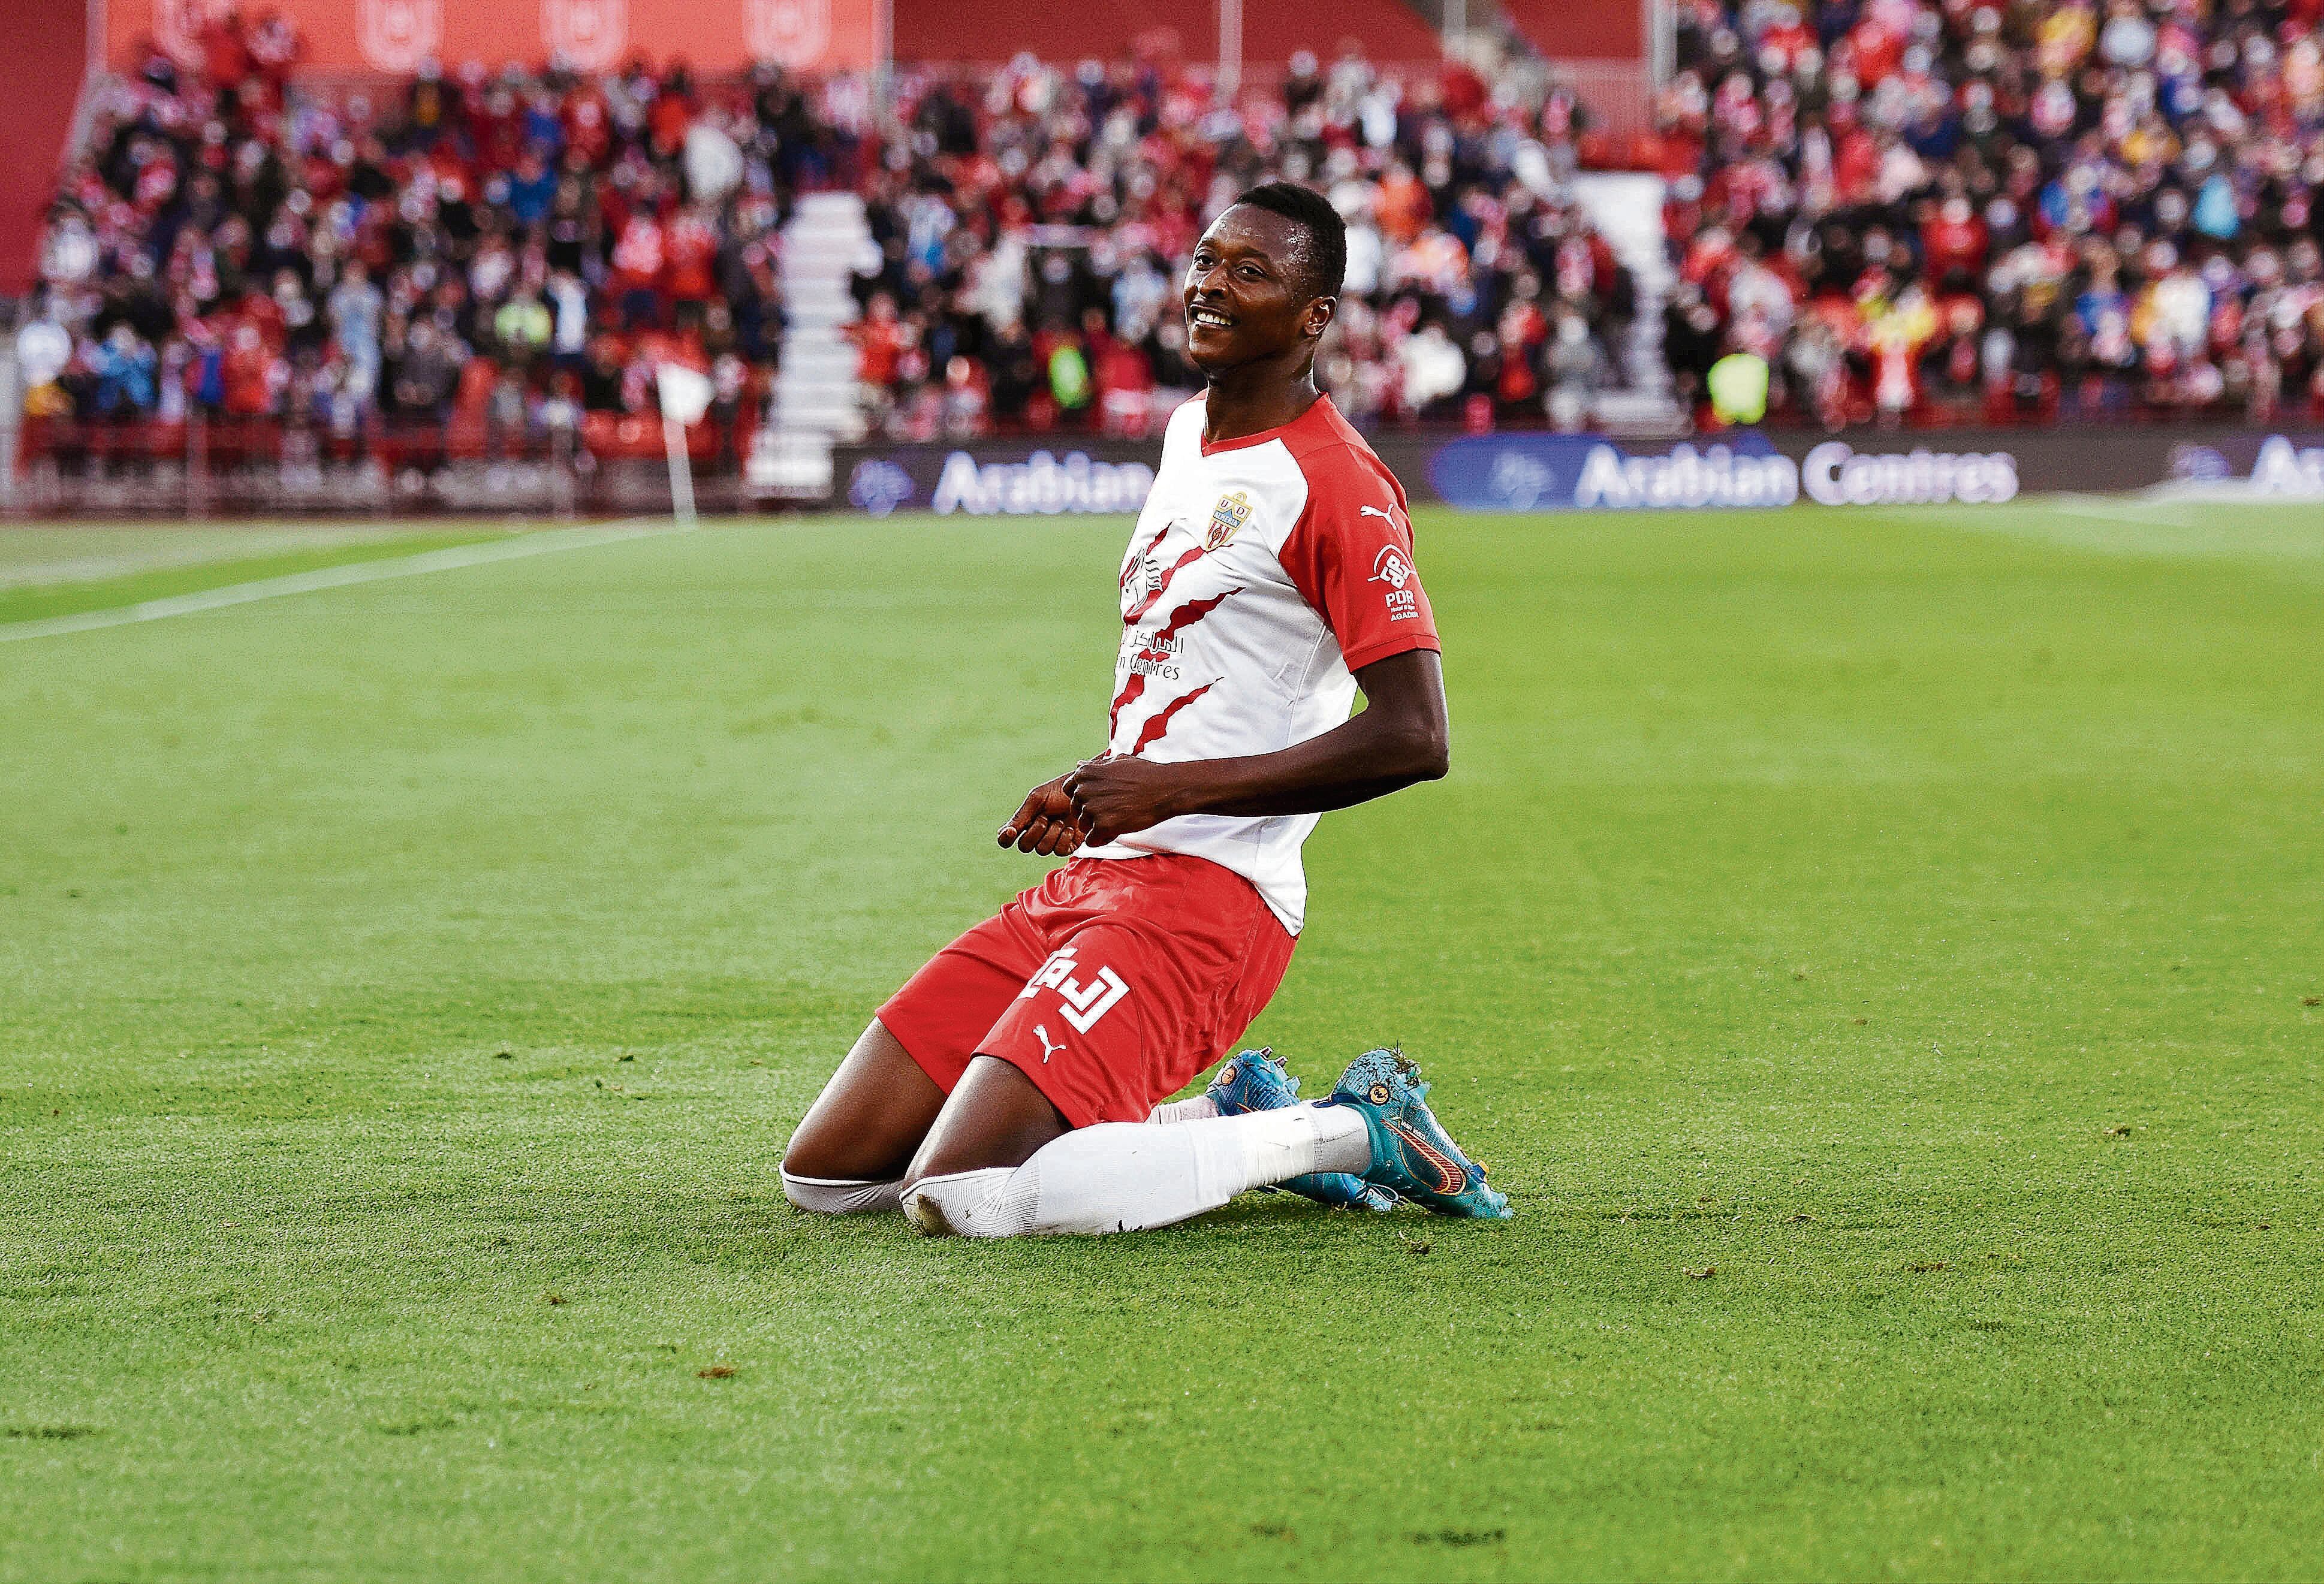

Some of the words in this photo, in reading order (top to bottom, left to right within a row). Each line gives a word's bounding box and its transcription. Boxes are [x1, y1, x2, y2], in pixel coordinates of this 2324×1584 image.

[932, 449, 1155, 514] Arabian
[1575, 443, 1798, 508] Arabian
[1802, 441, 2018, 505] Centres
[1385, 590, 1415, 608] PDR
[1130, 653, 1180, 680] Centres
